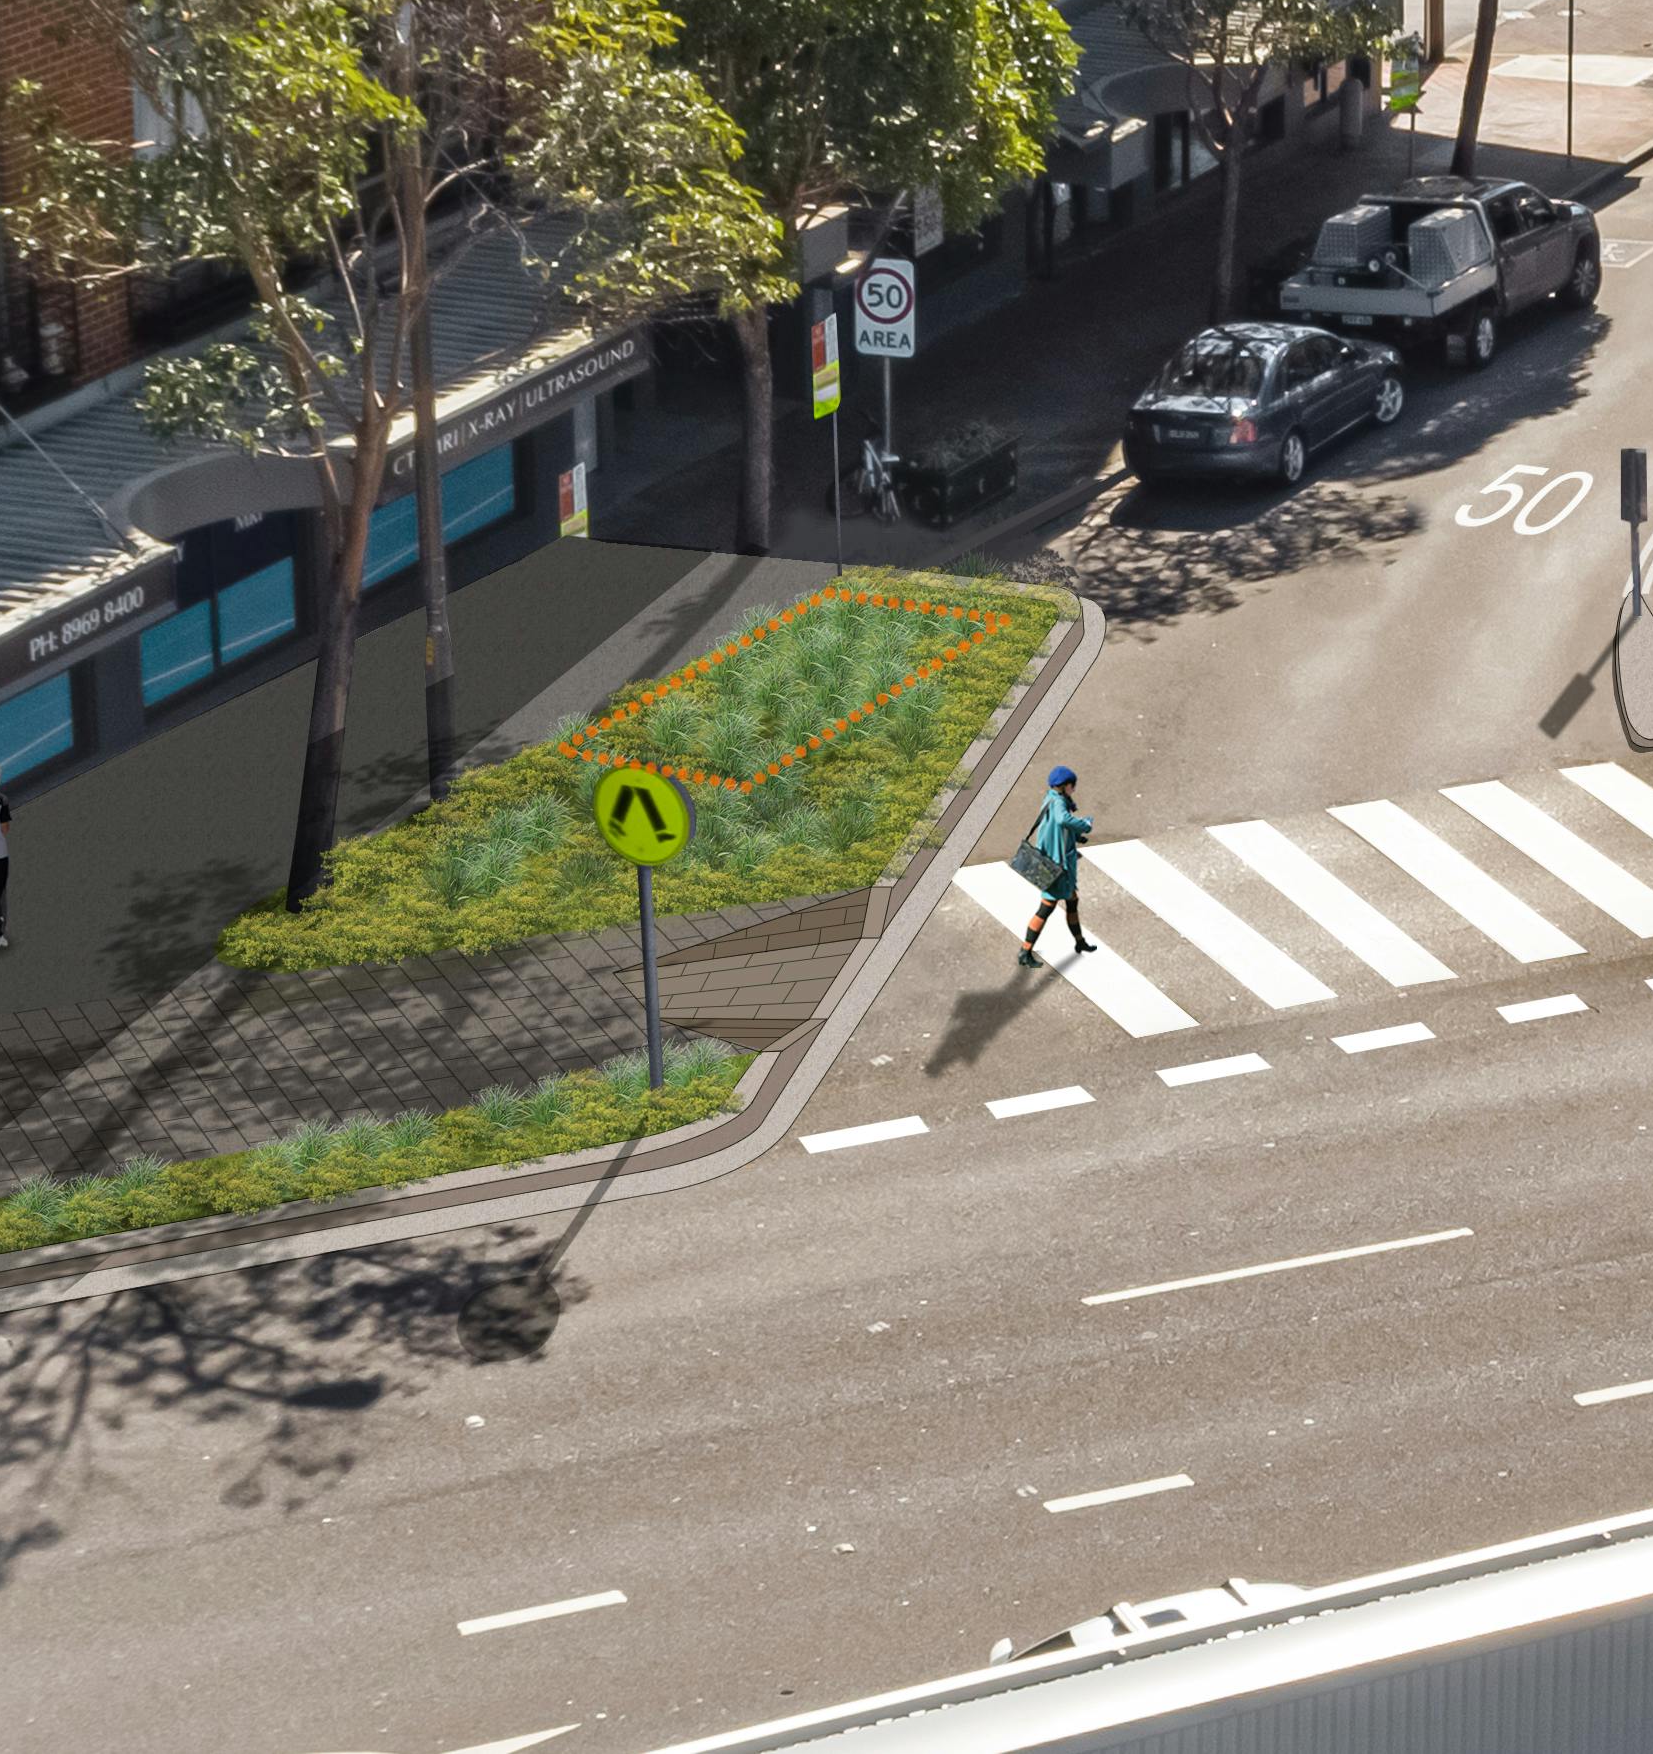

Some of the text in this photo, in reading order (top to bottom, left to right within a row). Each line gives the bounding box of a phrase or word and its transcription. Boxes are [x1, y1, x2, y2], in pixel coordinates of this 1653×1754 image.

[867, 282, 904, 309] 50
[858, 329, 912, 350] AREA
[393, 450, 416, 475] CT
[468, 401, 516, 439] X-RAY
[525, 339, 635, 409] ULTRASOUND
[1455, 464, 1594, 535] 50
[28, 633, 58, 662] PH:
[62, 608, 100, 646] 8969
[103, 586, 144, 624] 8400
